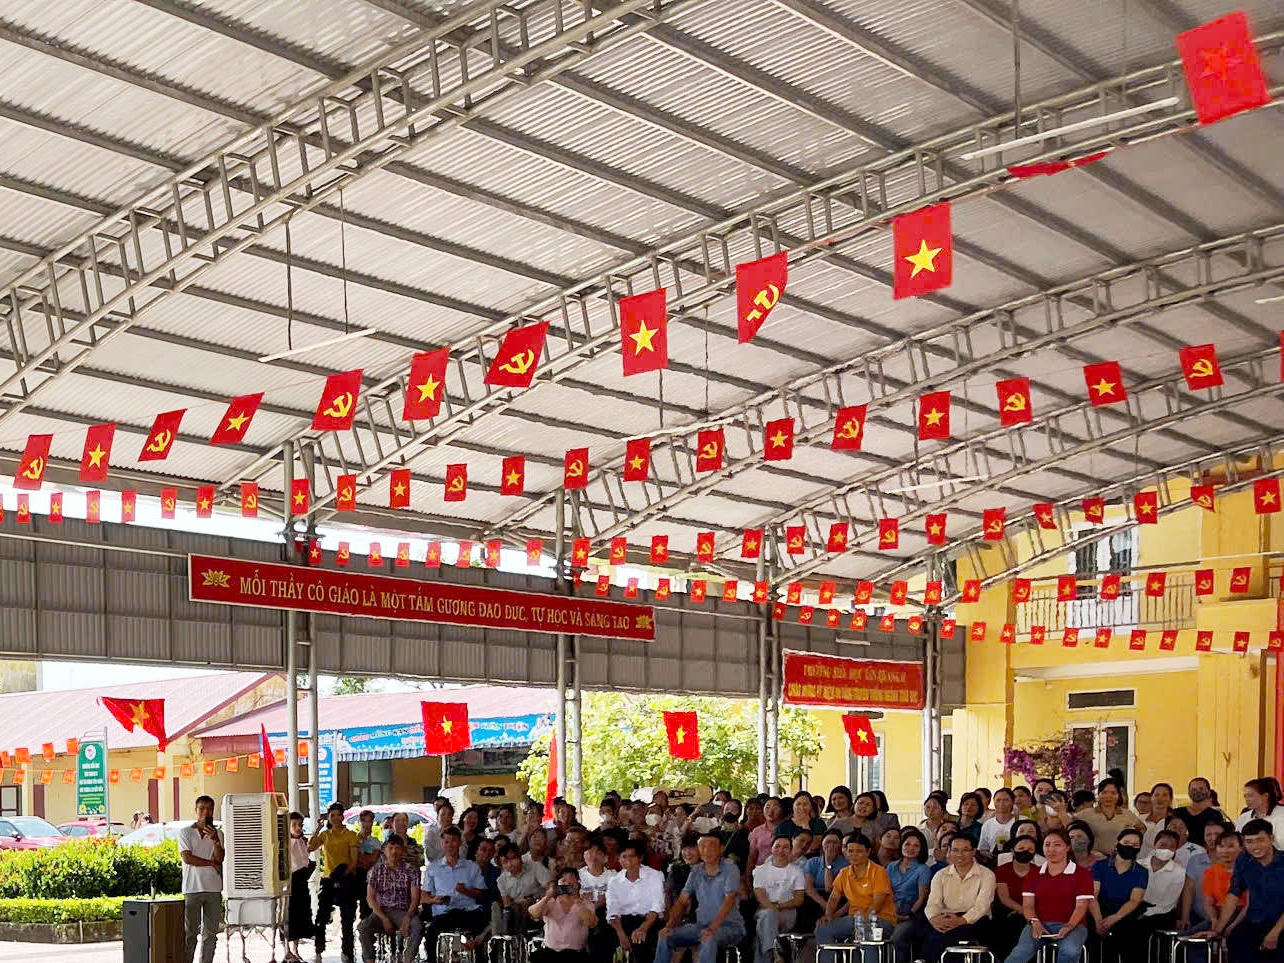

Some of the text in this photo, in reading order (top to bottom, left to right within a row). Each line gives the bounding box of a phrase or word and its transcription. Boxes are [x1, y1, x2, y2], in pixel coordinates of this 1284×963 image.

[307, 580, 325, 601] CÔ
[328, 582, 359, 605] GIÁO
[362, 584, 378, 607] LÀ
[547, 608, 568, 628] HỌC
[569, 607, 583, 627] VÀ
